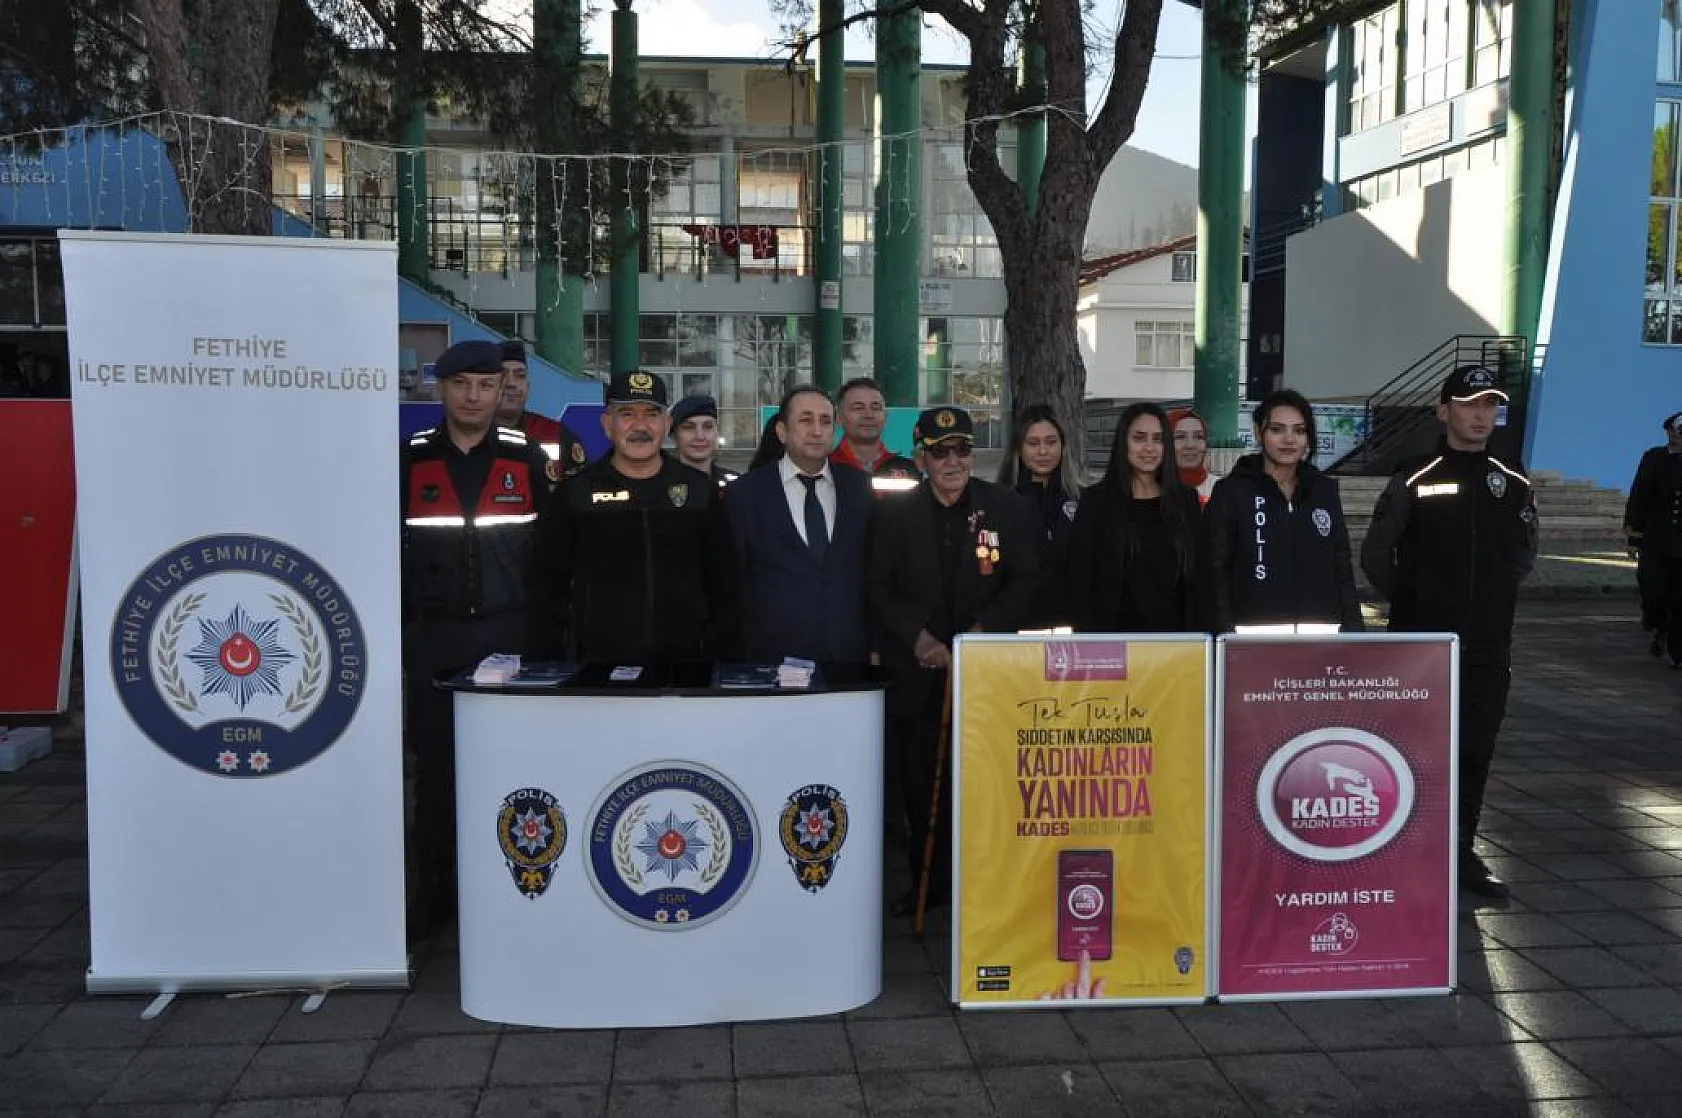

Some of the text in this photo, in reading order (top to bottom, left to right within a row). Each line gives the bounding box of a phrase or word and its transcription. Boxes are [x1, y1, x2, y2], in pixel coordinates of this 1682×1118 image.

[193, 334, 287, 359] FETHİYE
[78, 358, 387, 392] İLÇE EMNİYET MÜDÜRLÜĞÜ
[202, 545, 300, 575] EMNİYET
[1325, 666, 1349, 676] T.C.
[1329, 676, 1399, 688] BAKANLIĞI
[1243, 690, 1300, 702] EMNİYET
[1303, 691, 1344, 702] GENEL
[222, 727, 263, 743] EGM
[1016, 746, 1154, 777] KADINLARIN
[1016, 778, 1152, 819] YANINDA
[1291, 796, 1380, 819] KADES
[1275, 887, 1396, 907] YARDIM İSTE
